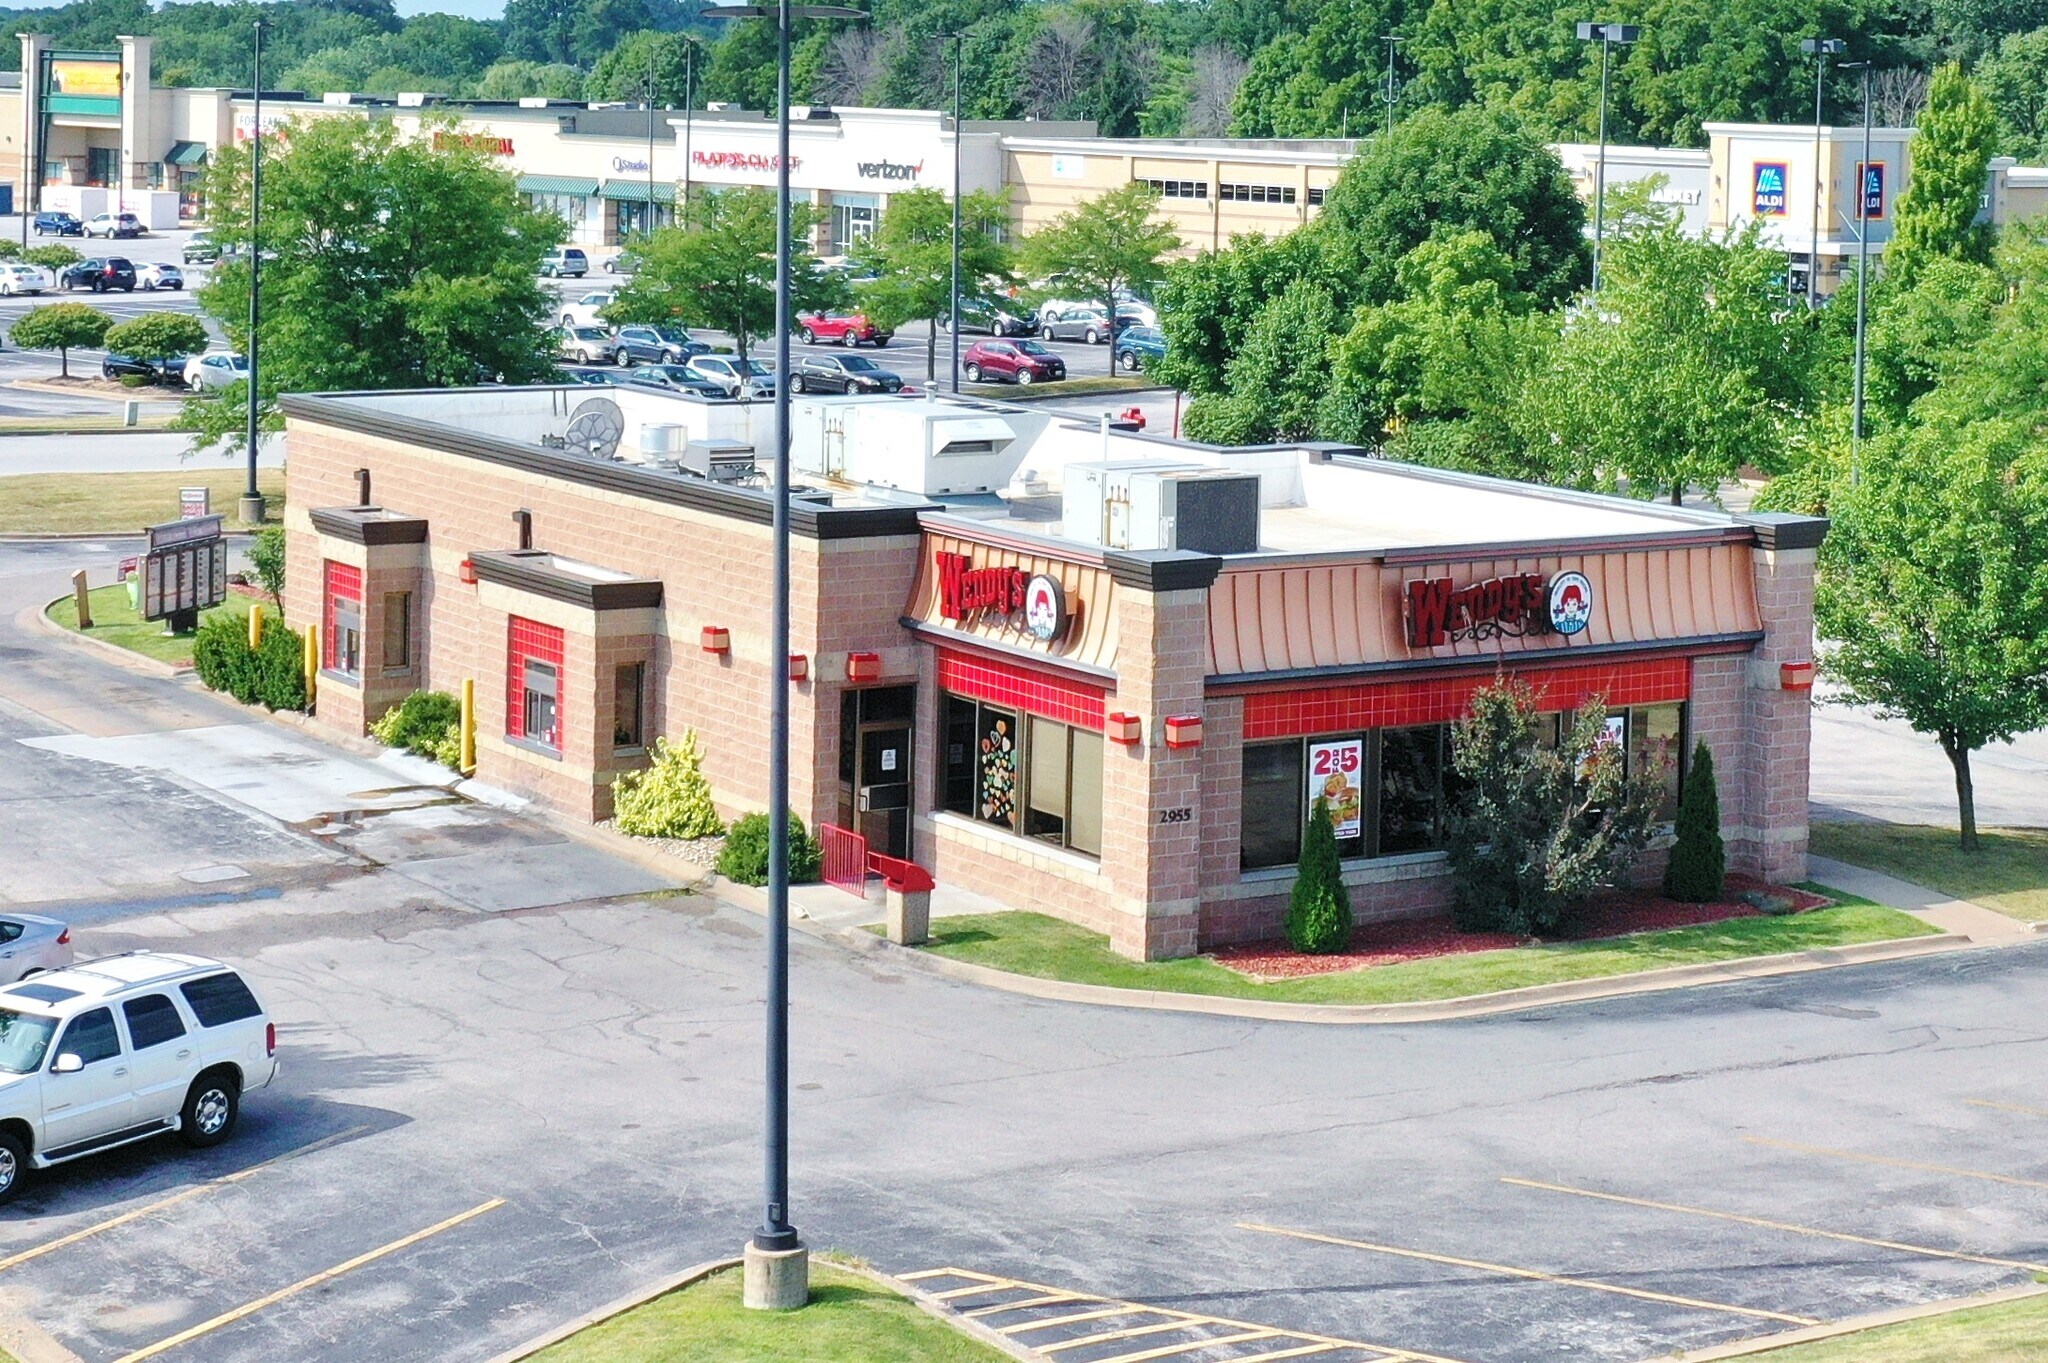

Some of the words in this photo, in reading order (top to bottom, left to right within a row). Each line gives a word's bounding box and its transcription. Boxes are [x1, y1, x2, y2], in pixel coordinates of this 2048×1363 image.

[748, 153, 799, 170] CLOST
[857, 159, 917, 181] verizon
[1755, 195, 1783, 207] ALDI
[1862, 197, 1881, 208] LDI
[1314, 749, 1331, 775] 2
[1341, 746, 1358, 772] 5
[1160, 808, 1192, 823] 2955
